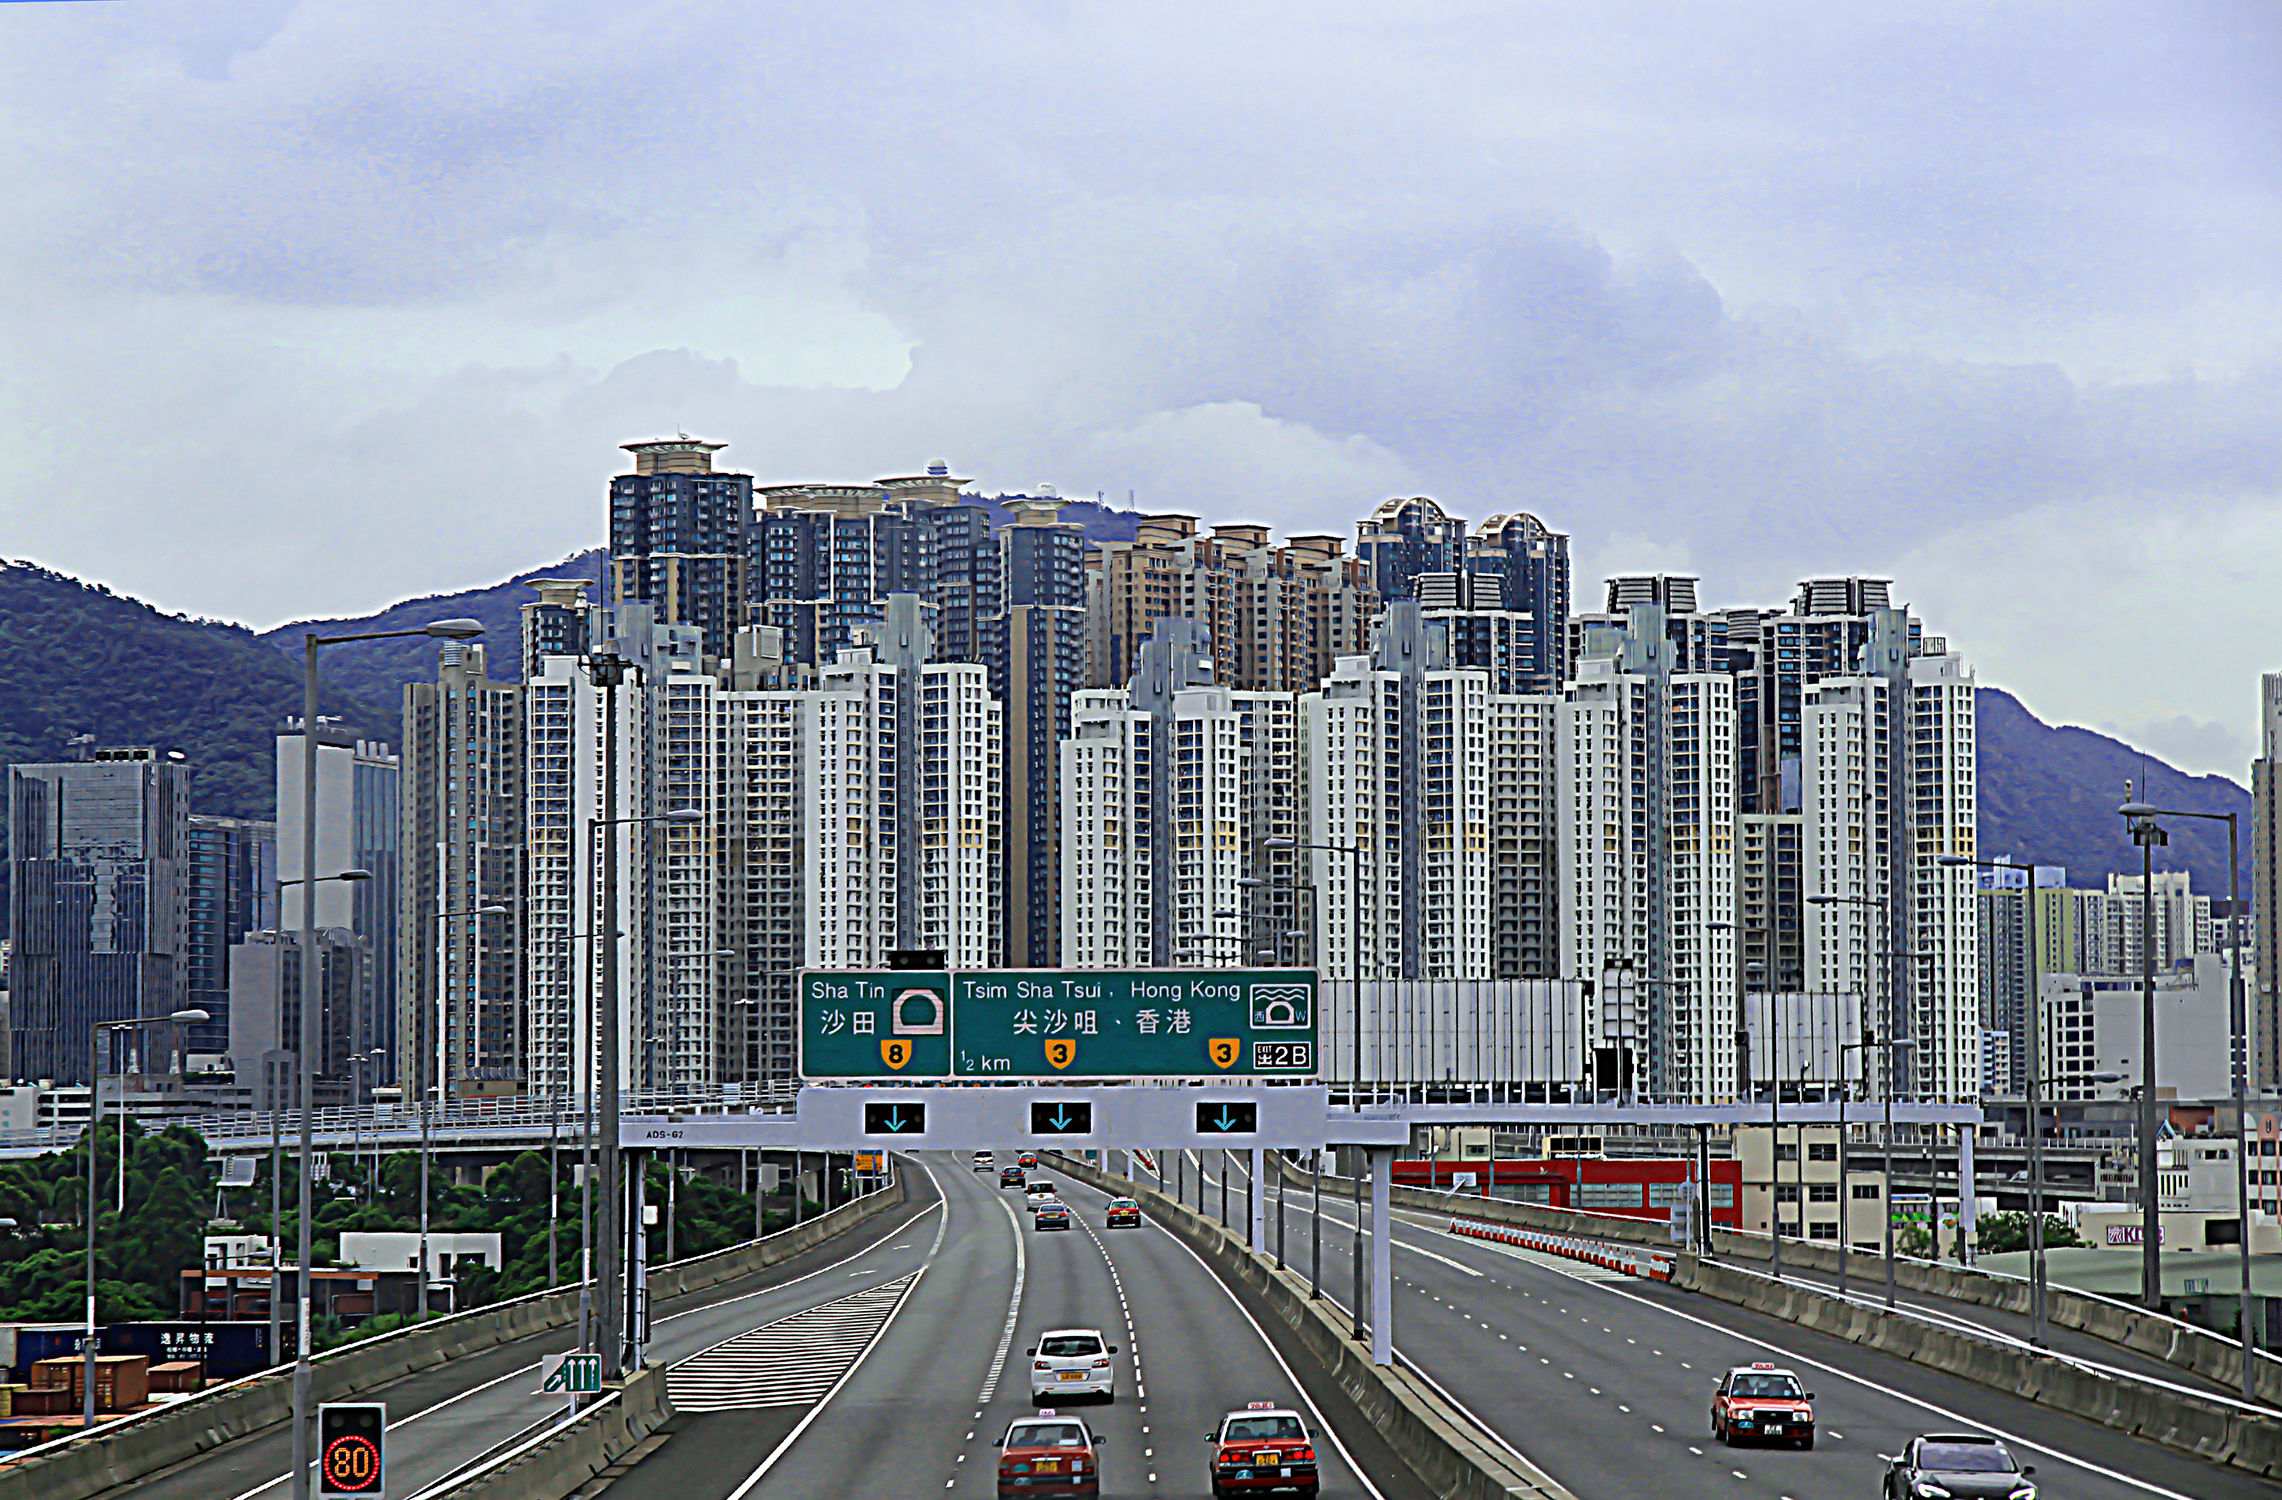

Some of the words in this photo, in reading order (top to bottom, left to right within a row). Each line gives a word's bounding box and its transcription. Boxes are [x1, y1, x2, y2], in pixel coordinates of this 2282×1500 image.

[811, 981, 848, 999] Sha
[855, 981, 885, 999] Tin
[963, 980, 1008, 999] Tsim
[1016, 980, 1054, 999] Sha
[1131, 980, 1182, 1002] Hong
[1190, 980, 1241, 1002] Kong
[820, 1009, 875, 1035] 沙田
[1294, 1010, 1306, 1022] W
[889, 1044, 904, 1064] 8
[1052, 1043, 1068, 1064] 3
[1216, 1043, 1232, 1063] 3
[1257, 1045, 1273, 1054] EXIT
[981, 1055, 1011, 1071] km
[1257, 1054, 1273, 1066] 出
[334, 1447, 369, 1478] 80
